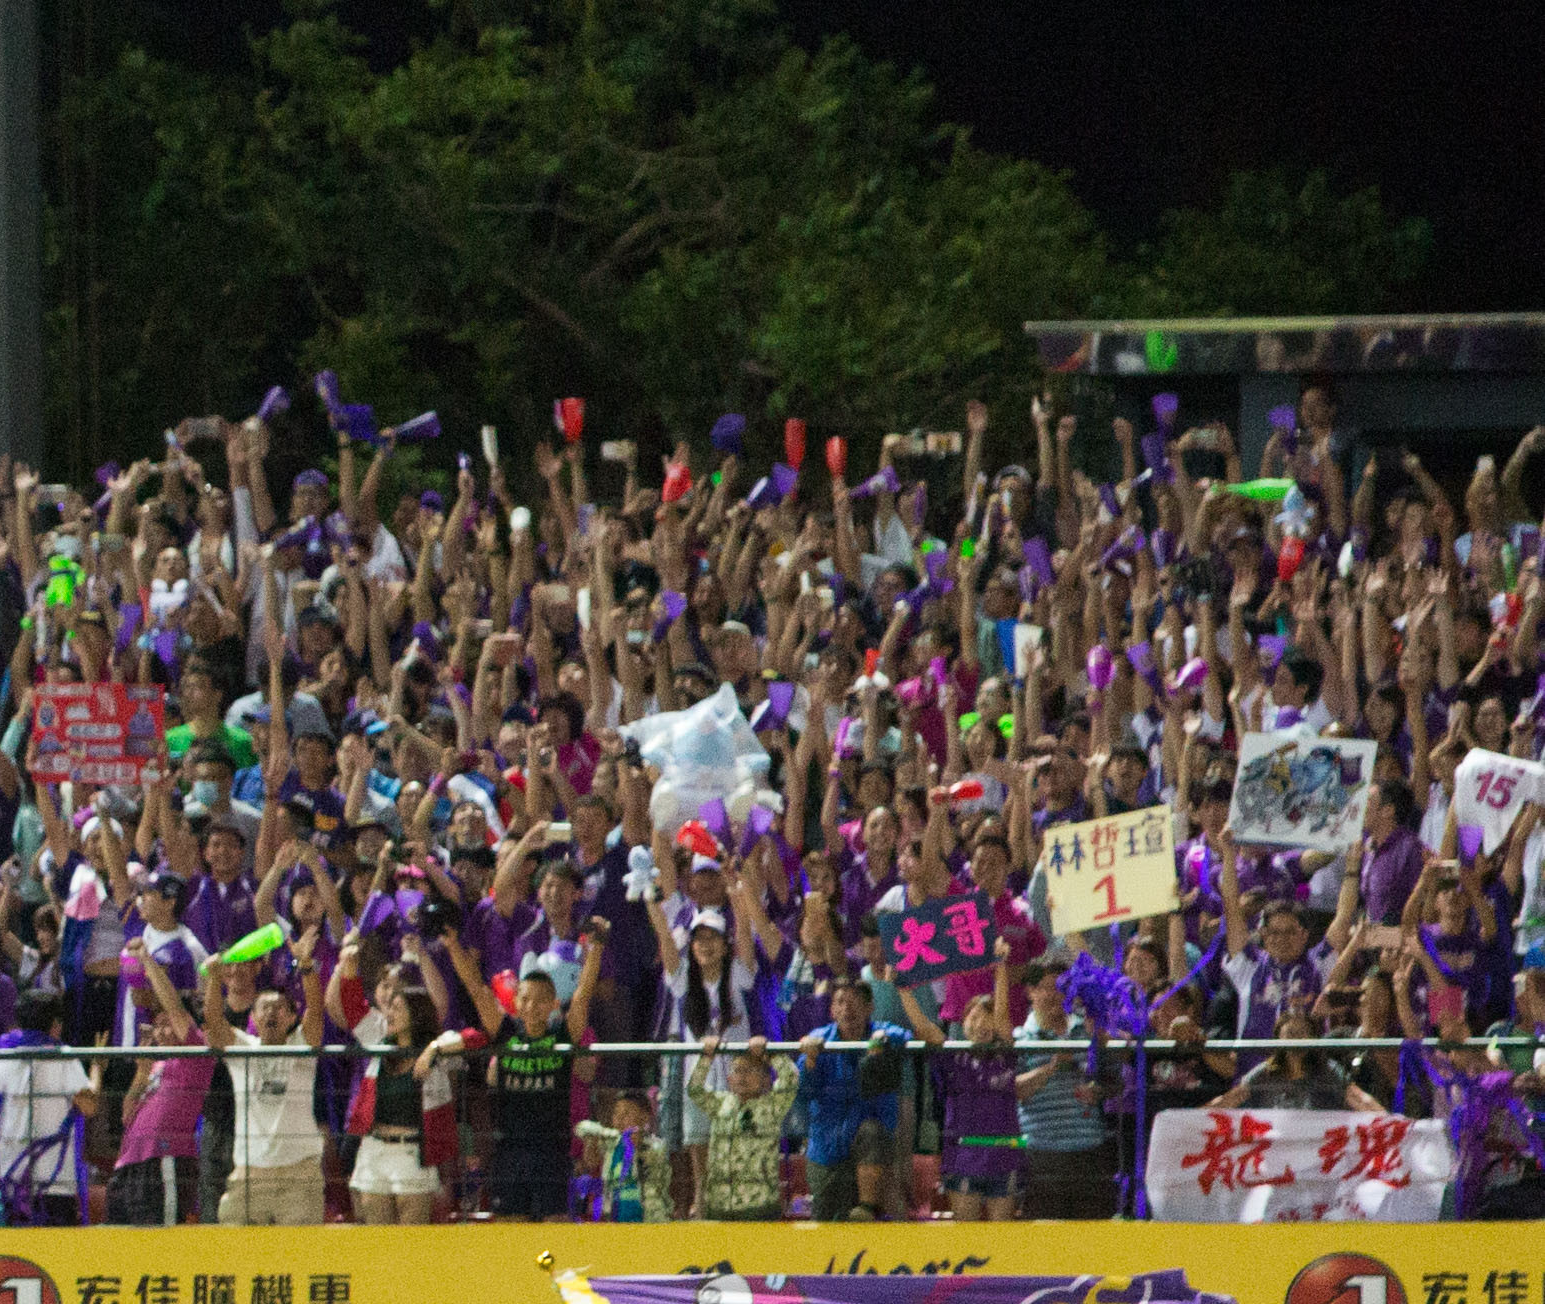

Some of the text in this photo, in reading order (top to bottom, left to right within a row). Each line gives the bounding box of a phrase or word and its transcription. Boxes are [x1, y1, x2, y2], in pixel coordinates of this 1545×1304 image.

[1475, 770, 1515, 809] 15
[1049, 815, 1165, 875] 林哲瑄
[1093, 875, 1131, 920] 1
